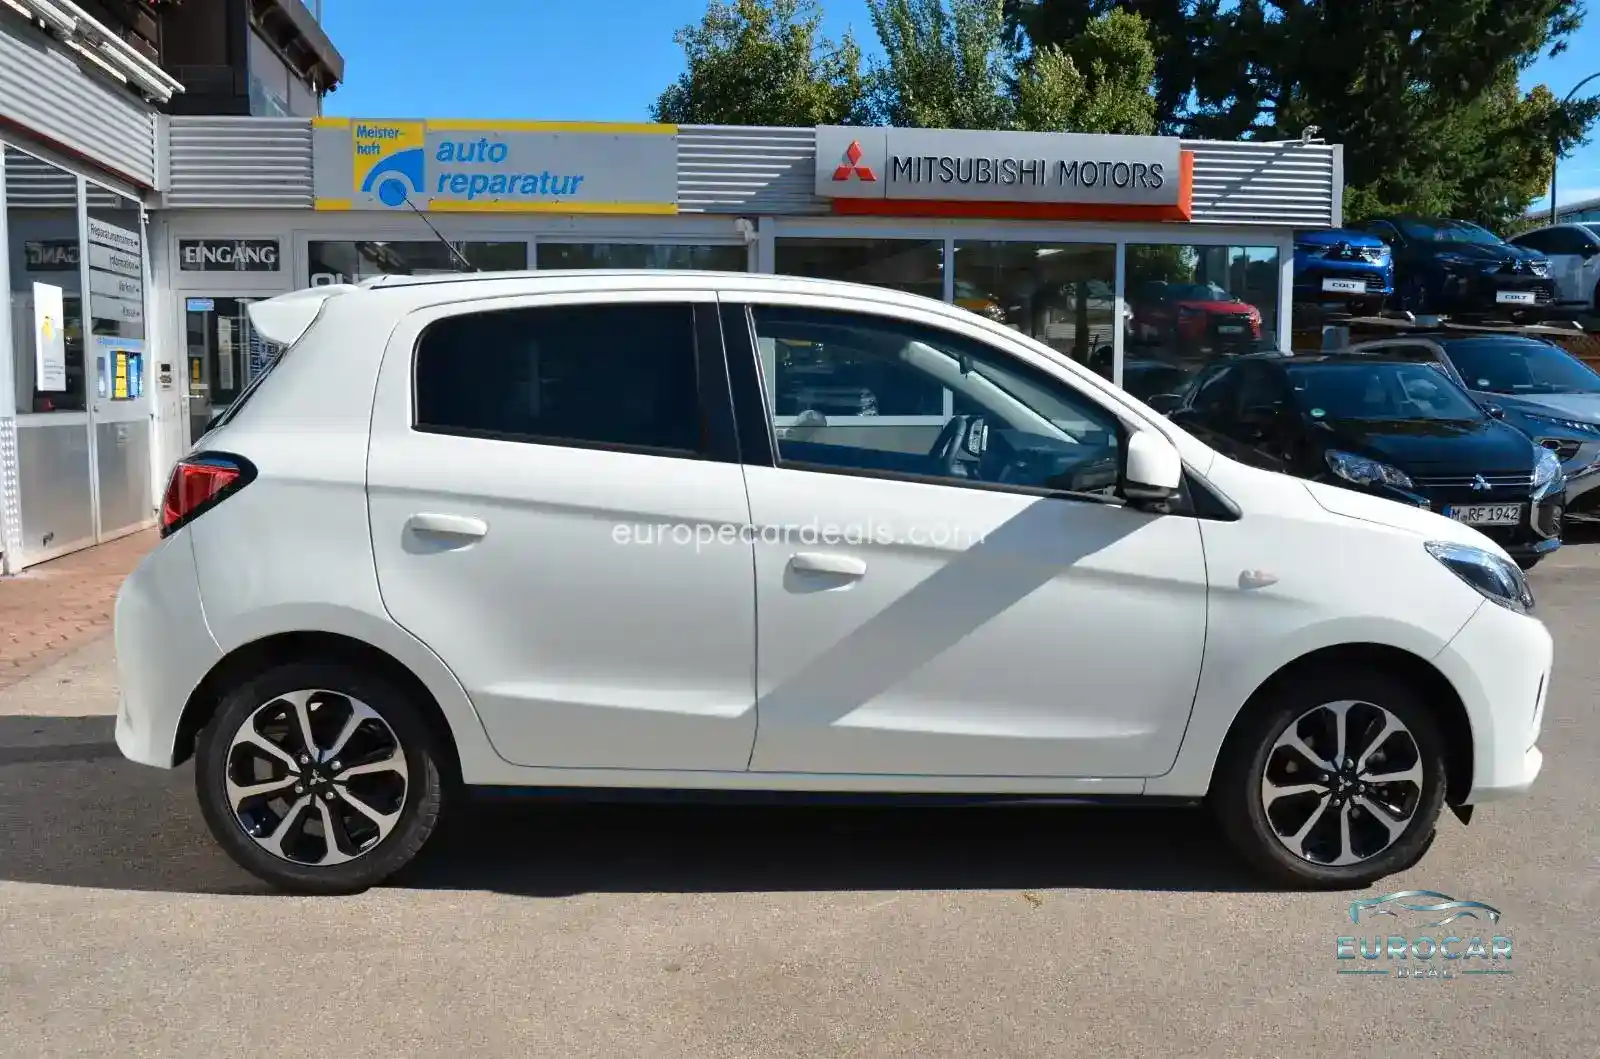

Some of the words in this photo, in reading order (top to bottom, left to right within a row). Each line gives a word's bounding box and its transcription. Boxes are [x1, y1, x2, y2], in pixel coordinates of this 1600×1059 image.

[357, 124, 406, 139] Meister-
[435, 136, 508, 163] auto
[893, 155, 1046, 187] MITSUBISHI
[1059, 159, 1165, 190] MOTORS
[437, 171, 585, 201] reparatur
[185, 246, 276, 264] EINGANG
[1468, 507, 1487, 522] RF
[1487, 506, 1520, 522] 1942
